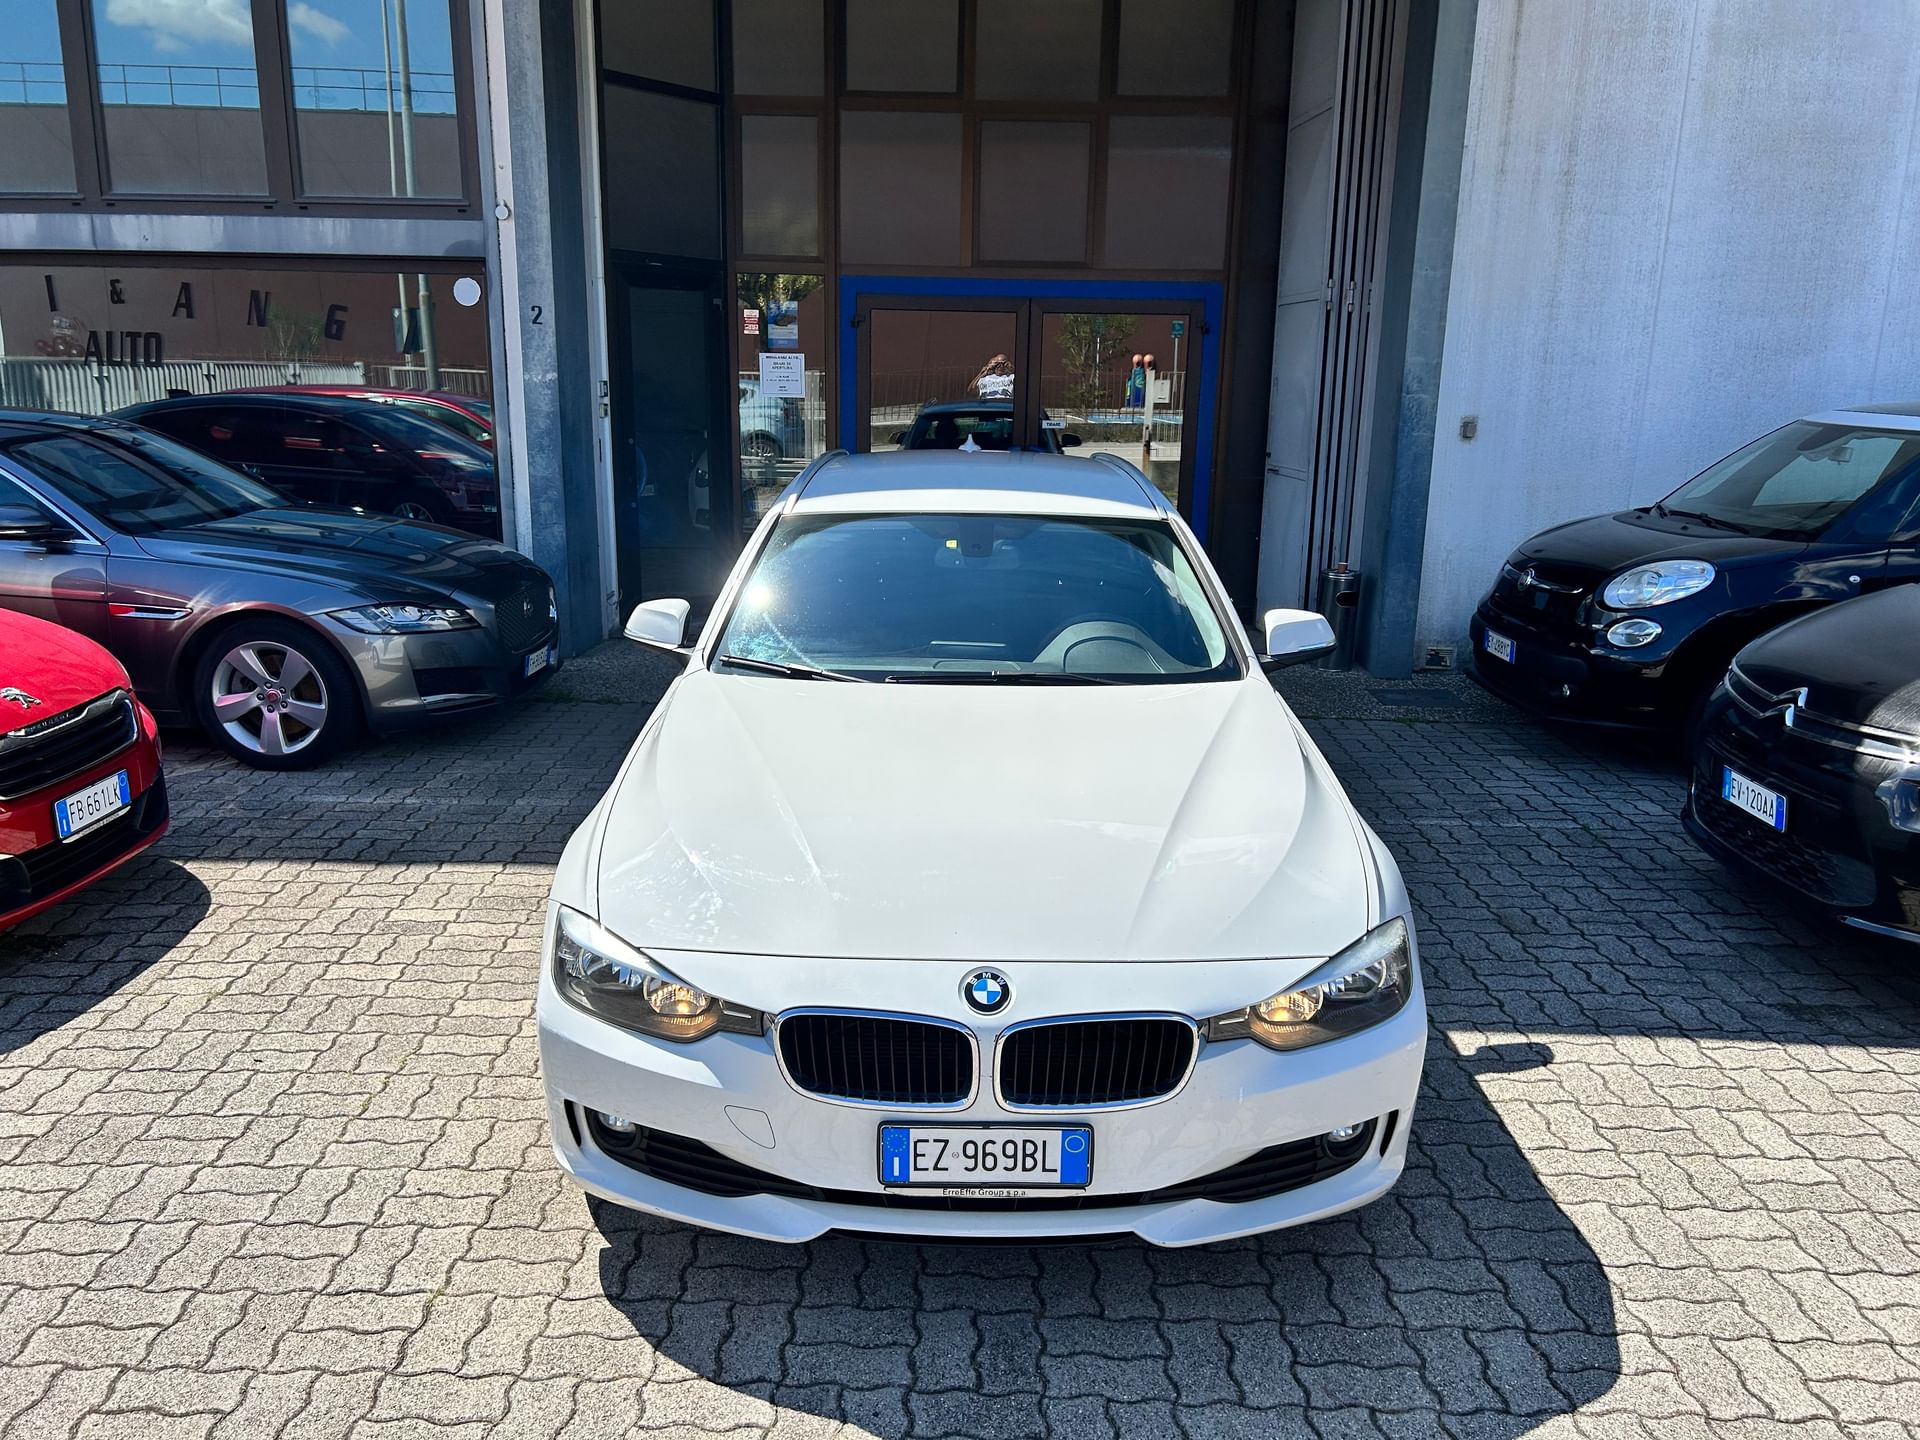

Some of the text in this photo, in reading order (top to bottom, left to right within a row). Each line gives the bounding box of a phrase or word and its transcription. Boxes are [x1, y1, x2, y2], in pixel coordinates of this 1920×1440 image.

[530, 305, 543, 325] 2
[84, 330, 162, 367] AUTO
[913, 1138, 950, 1172] EZ
[962, 1139, 1058, 1173] 969BL
[978, 1188, 1004, 1198] Group
